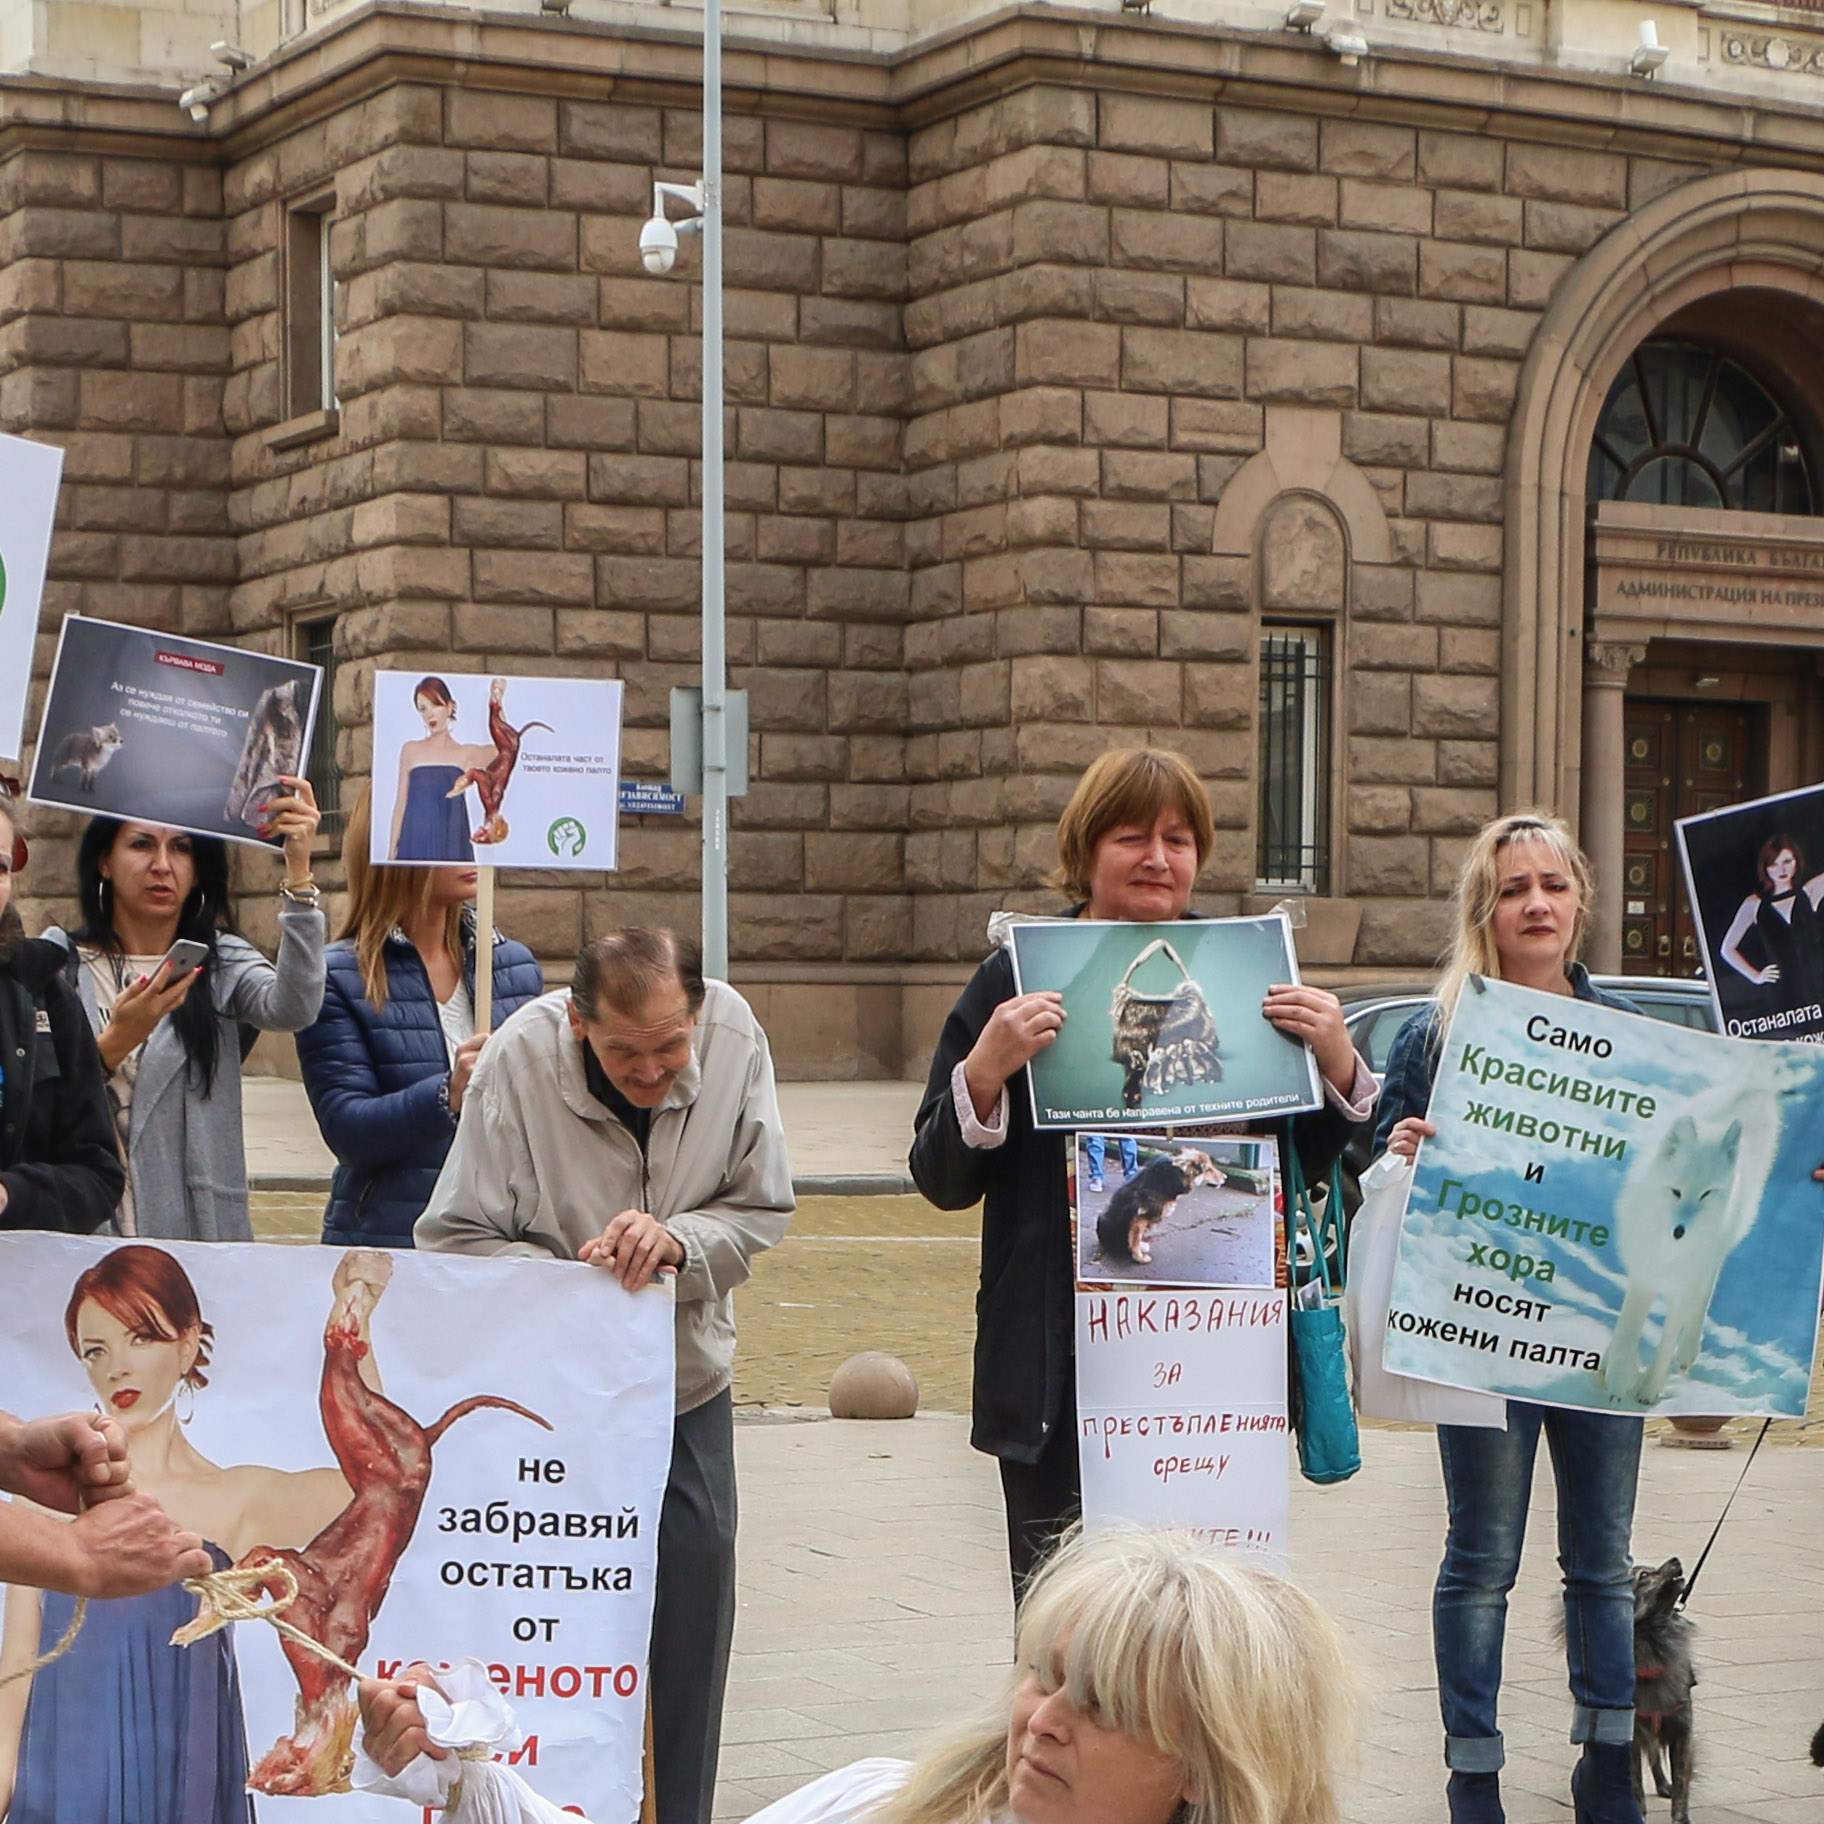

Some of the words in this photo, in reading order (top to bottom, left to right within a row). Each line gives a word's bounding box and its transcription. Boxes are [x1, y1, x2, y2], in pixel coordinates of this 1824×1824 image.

[1657, 542, 1757, 565] РЕПУБЛИКА
[1616, 580, 1757, 604] АДМИНИСТРАЦИЯ
[1760, 590, 1782, 606] НА
[110, 681, 124, 692] Аз
[125, 685, 137, 694] се
[138, 688, 173, 702] нуждая
[128, 698, 161, 711] повече
[120, 708, 132, 717] се
[520, 752, 571, 763] Останалата
[573, 755, 593, 763] част
[523, 764, 551, 773] твоето
[553, 766, 584, 774] кожено
[585, 767, 612, 775] палто
[620, 791, 681, 802] ЕЗАВИСИМОСТ
[1727, 1003, 1823, 1037] Останалата
[1525, 1014, 1614, 1059] Само
[1457, 1042, 1658, 1121] Красивите
[1045, 1108, 1071, 1120] Тази
[1073, 1107, 1104, 1120] чанта
[1106, 1105, 1121, 1118] бе
[1122, 1104, 1181, 1120] направена
[1183, 1104, 1197, 1115] от
[1200, 1100, 1243, 1114] техните
[1246, 1093, 1300, 1110] родители
[1462, 1100, 1627, 1162] животни
[1523, 1162, 1546, 1185] и
[1436, 1179, 1610, 1248] Грозните
[1466, 1240, 1557, 1284] хора
[1452, 1282, 1552, 1324] носят
[1088, 1296, 1284, 1344] НАКАЗАНИЯ
[1386, 1307, 1501, 1354] кожени
[1507, 1338, 1602, 1373] палта
[1153, 1362, 1182, 1389] ЗА
[1083, 1413, 1286, 1459] ПРЕСТЪПЛЕНИЯТА
[517, 1457, 566, 1484] не
[436, 1500, 639, 1543] забравяй
[440, 1560, 633, 1591] остатъка
[512, 1617, 561, 1643] от
[377, 1659, 639, 1698] кеното
